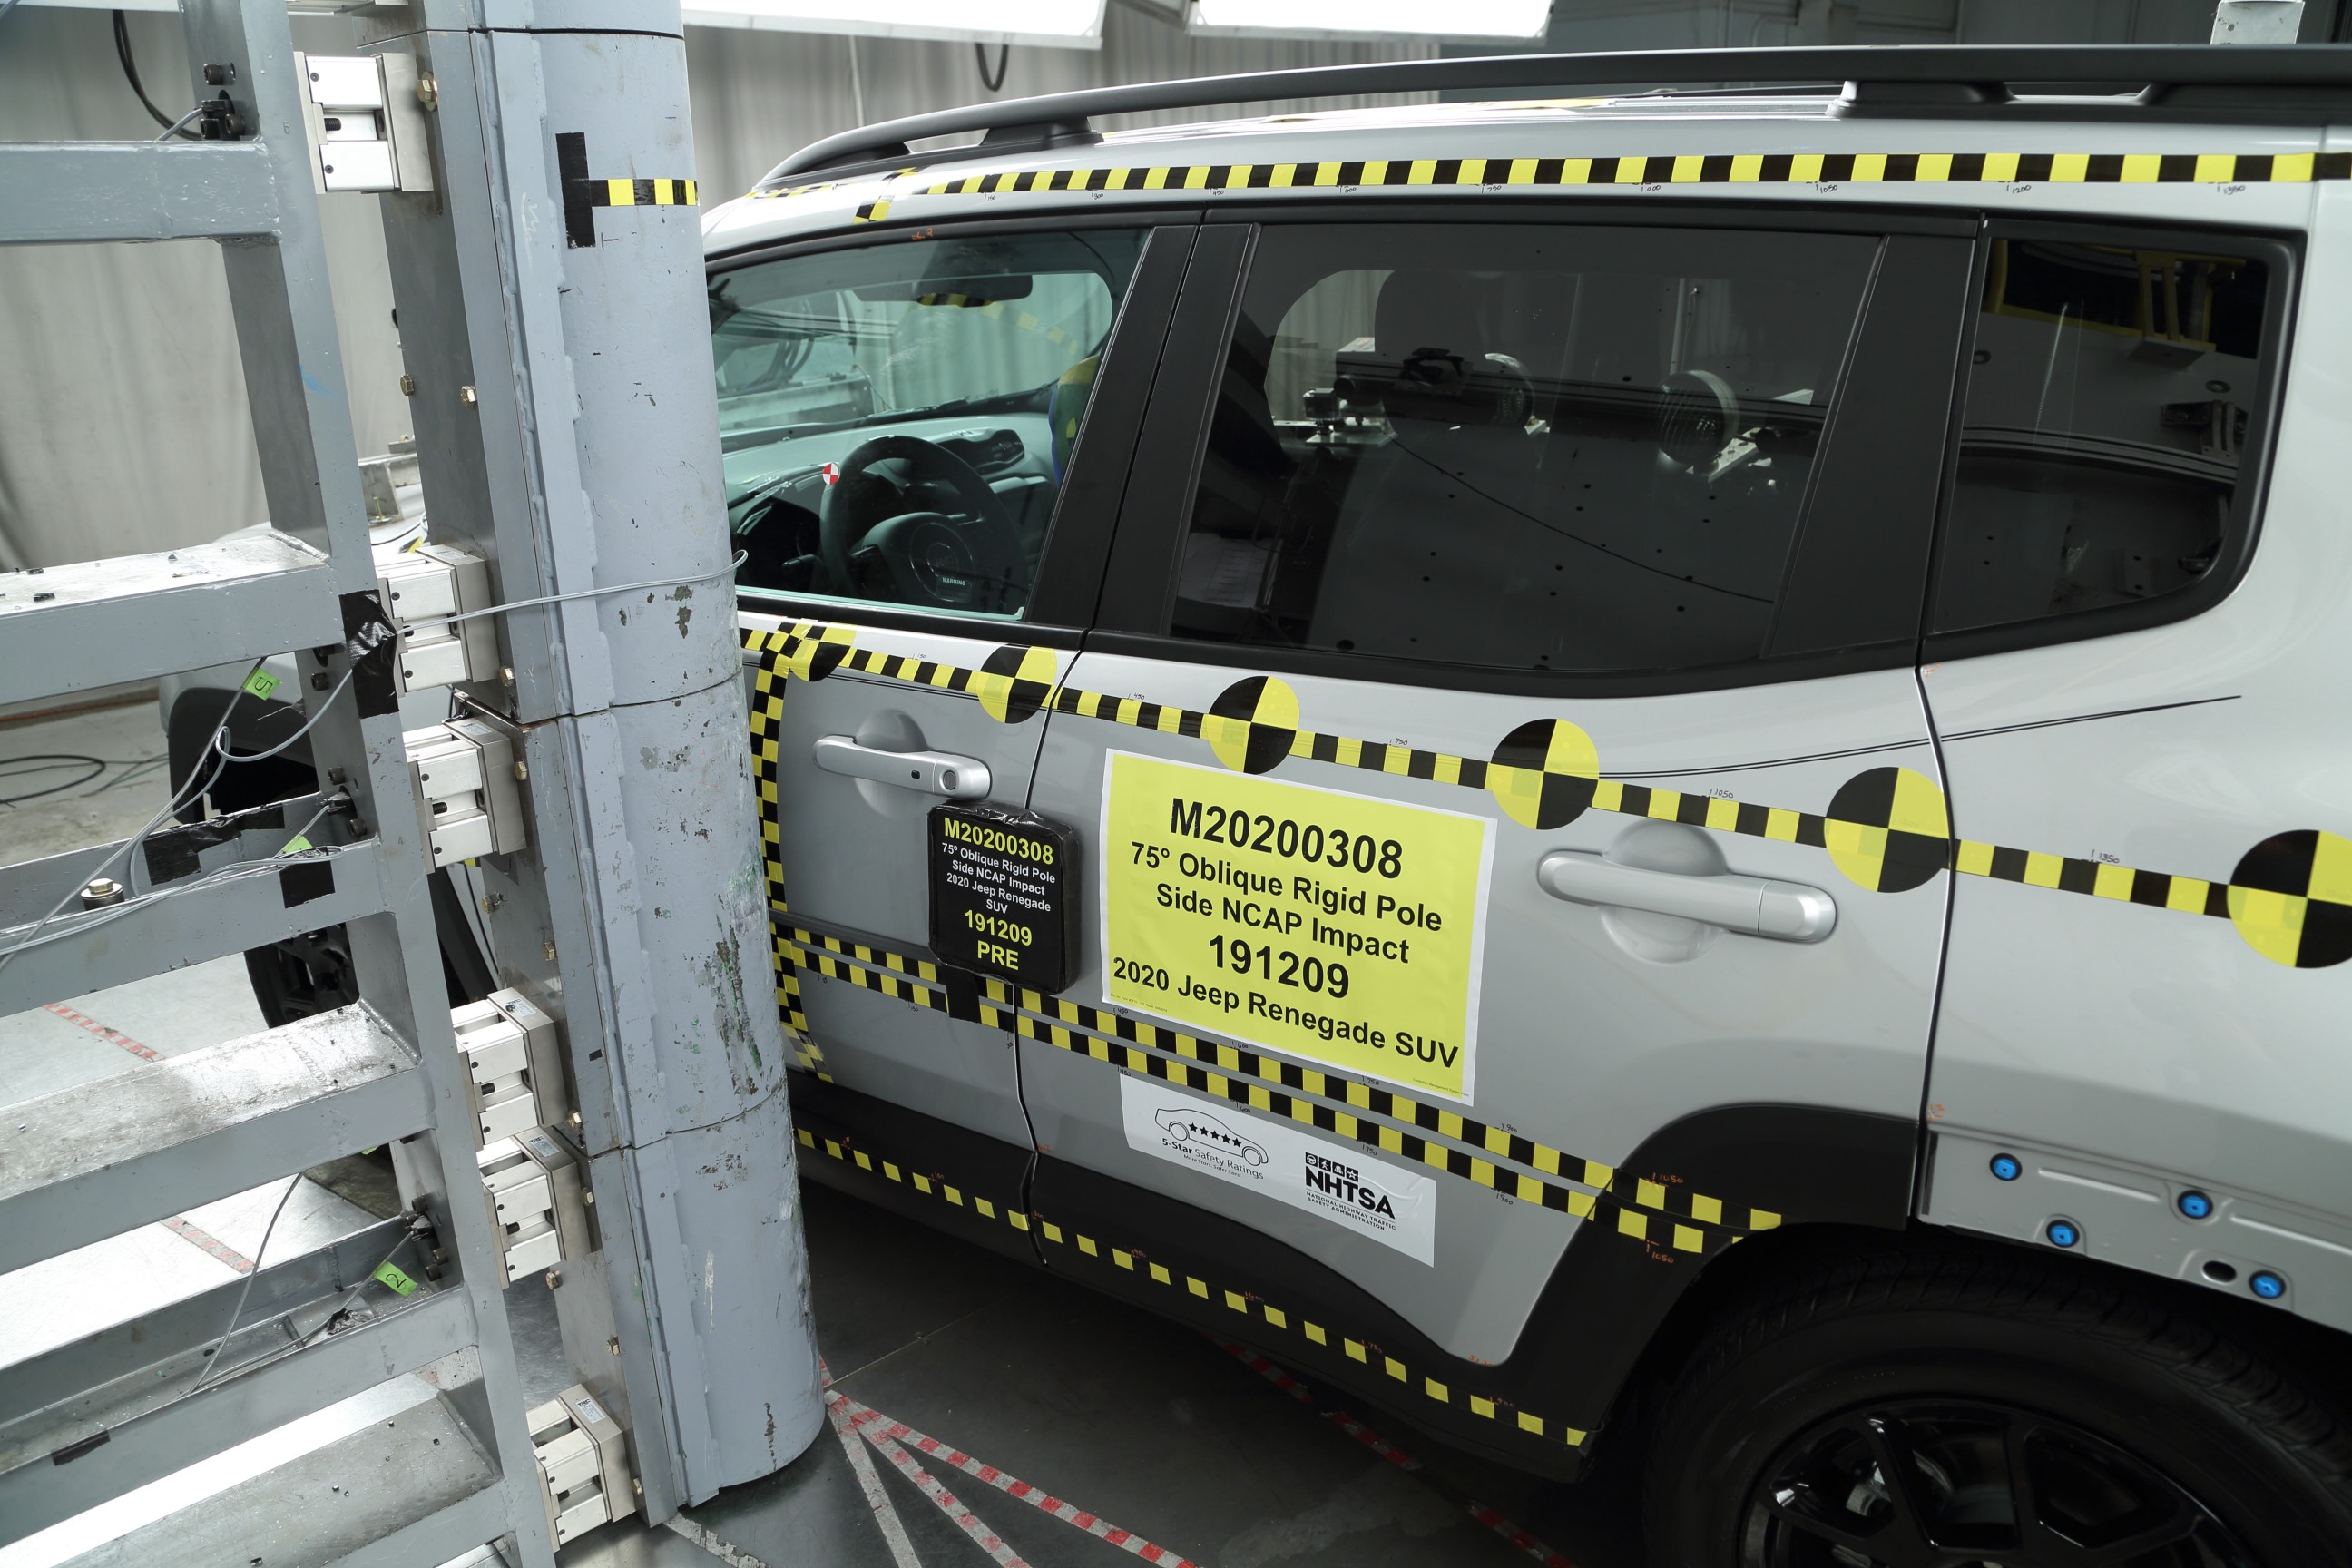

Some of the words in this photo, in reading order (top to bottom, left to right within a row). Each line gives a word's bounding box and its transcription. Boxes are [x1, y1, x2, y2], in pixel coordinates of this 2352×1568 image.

[1646, 184, 1661, 193] 900
[1820, 184, 1838, 194] 1050
[2012, 184, 2032, 194] 1200
[942, 576, 966, 586] WARNING
[1133, 692, 1145, 701] 450
[1395, 738, 1408, 746] 750
[1714, 788, 1734, 799] 1050
[944, 817, 1054, 865] M20200308
[1171, 798, 1403, 879] M20200308
[960, 848, 999, 868] Oblique
[1002, 858, 1029, 877] Rigid
[1032, 867, 1056, 884] Pole
[2098, 852, 2120, 864] 1350
[952, 859, 975, 876] Side
[976, 867, 1006, 884] NCAP
[1009, 876, 1045, 897] Impact
[946, 872, 969, 888] 2020
[971, 880, 996, 898] Jeep
[998, 887, 1052, 912] Renegade
[1179, 852, 1283, 897] Oblique
[1293, 876, 1366, 916] Rigid
[1377, 895, 1443, 932] Pole
[986, 898, 1008, 915] SUV
[965, 909, 1033, 946] 191209
[1156, 883, 1213, 916] Side
[1222, 897, 1302, 936] NCAP
[1312, 917, 1409, 964] Impact
[977, 939, 1019, 971] PRE
[1209, 934, 1349, 999] 191209
[1113, 956, 1170, 991] 2020
[1177, 975, 1240, 1010] Jeep
[1249, 990, 1387, 1049] Renegade
[1395, 1031, 1460, 1069] SUV
[1237, 1041, 1249, 1049] 600
[1367, 1077, 1380, 1086] 750
[1506, 1123, 1518, 1133] 900
[1162, 1137, 1193, 1154] 5-Star
[1195, 1148, 1225, 1167] Safety
[1227, 1159, 1264, 1180] Ratings
[1183, 1154, 1198, 1162] More
[1659, 1173, 1684, 1184] 1050
[1305, 1165, 1396, 1220] NHTSA
[1306, 1191, 1338, 1208] NATIONAL
[1338, 1203, 1368, 1220] HIGHWAY
[1369, 1215, 1396, 1230] TRAFFIC
[1307, 1196, 1330, 1209] SAFETY
[1331, 1206, 1386, 1231] ADMINISTRATION
[1651, 1251, 1674, 1264] 1050
[386, 1273, 407, 1289] 2
